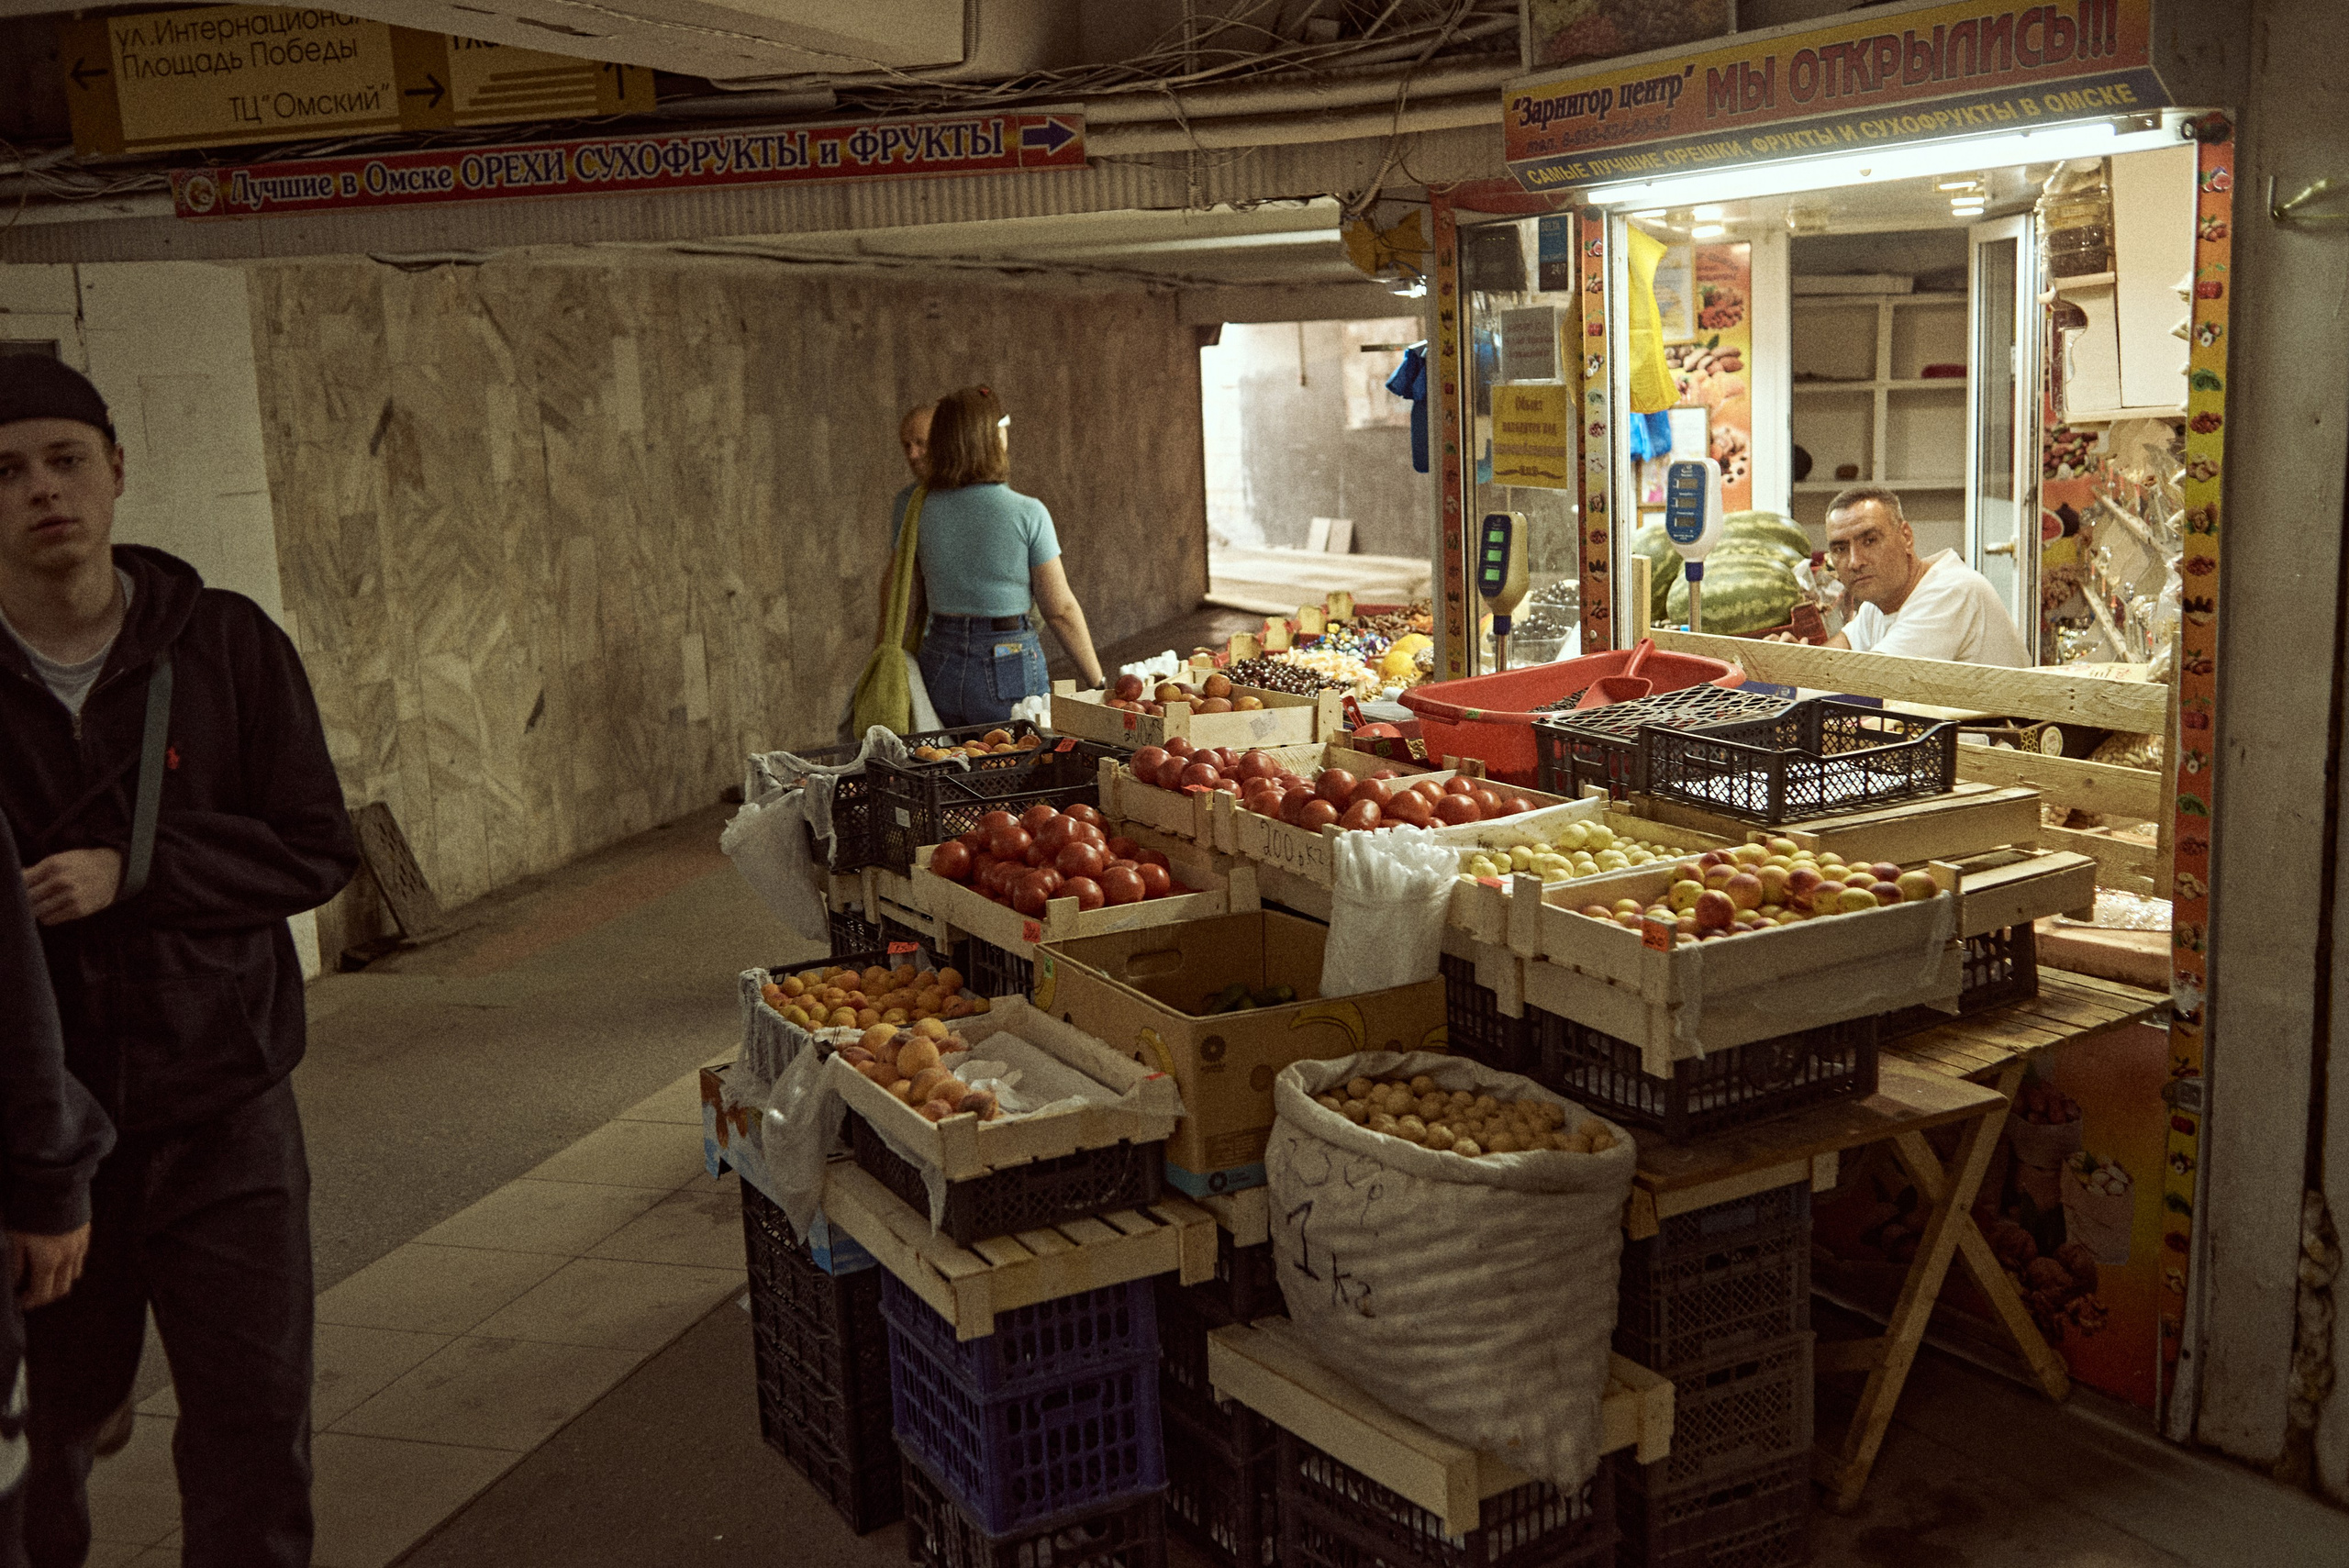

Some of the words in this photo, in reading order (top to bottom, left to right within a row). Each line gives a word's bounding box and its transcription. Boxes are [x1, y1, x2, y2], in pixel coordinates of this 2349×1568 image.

[116, 9, 377, 53] ул.Интернациона
[122, 51, 243, 80] Площадь
[250, 38, 359, 67] Победы
[1707, 60, 1775, 117] МЫ
[1789, 1, 2119, 104] ОТКРЫЛИСЬ!!!
[1512, 89, 1613, 130] "Зарнигор
[1620, 64, 1695, 108] центр"
[1526, 162, 1590, 184] САМЫЕ
[1588, 151, 1664, 177] ЛУЧШИЕ
[1664, 139, 1753, 165] ОРЕШКИ,
[1753, 126, 1836, 155] ФРУКТЫ
[1841, 123, 1860, 141] И
[1860, 100, 2019, 139] СУХОФРУКТЫ
[2022, 98, 2041, 117] В
[2043, 83, 2139, 113] ОМСКЕ
[230, 172, 333, 207] Лучшие
[340, 176, 356, 195] в
[367, 161, 451, 195] Омске
[462, 148, 566, 187] ОРЕХИ
[574, 132, 808, 182] СУХОФРУКТЫ
[819, 142, 839, 165] и
[850, 121, 1005, 163] ФРУКТЫ
[1260, 819, 1294, 863] 200
[1286, 1199, 1320, 1282] 1
